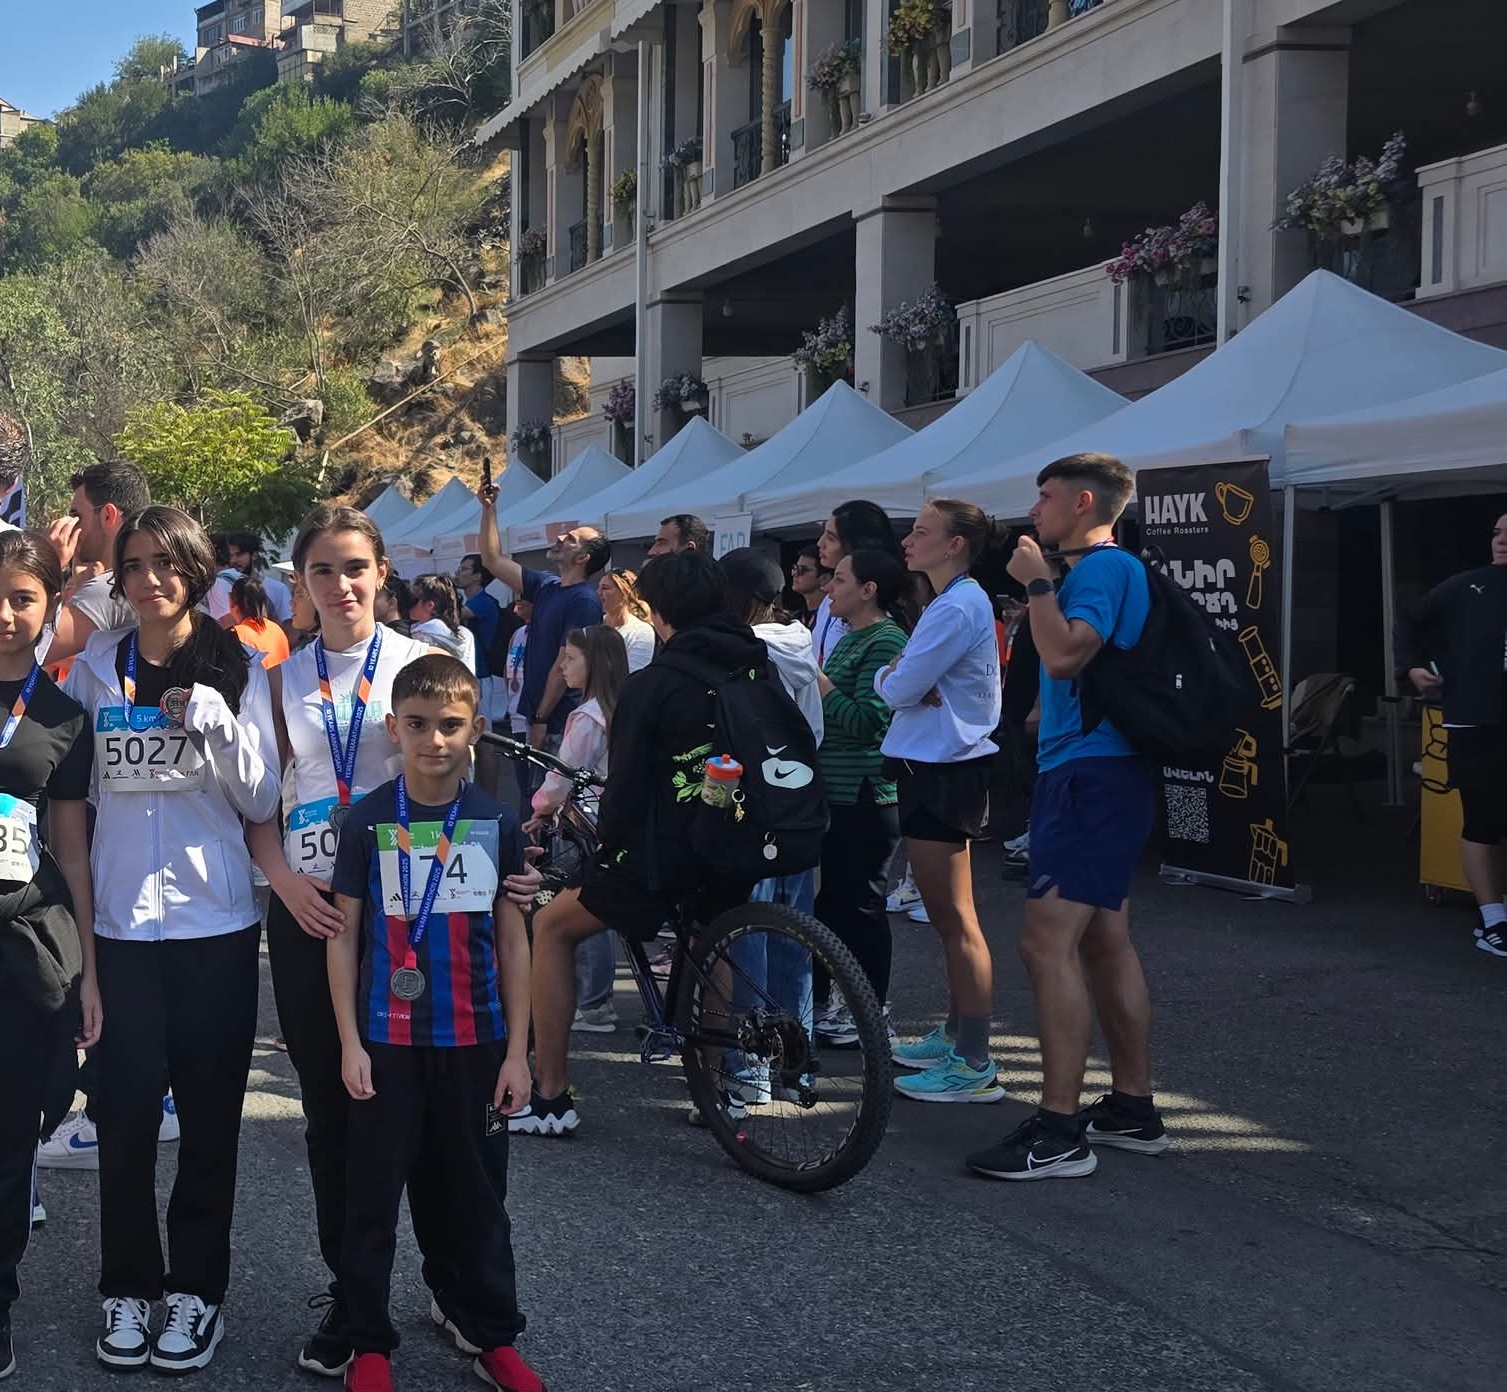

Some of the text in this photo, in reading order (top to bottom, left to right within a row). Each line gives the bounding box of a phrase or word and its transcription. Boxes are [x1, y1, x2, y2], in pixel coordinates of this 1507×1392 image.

[1144, 492, 1208, 525] HAYK
[1146, 526, 1209, 536] Coffee Roasters
[137, 714, 143, 722] 5
[105, 736, 188, 766] 5027
[301, 828, 336, 861] 50
[422, 882, 437, 916] MARATHON
[432, 867, 442, 882] 2025
